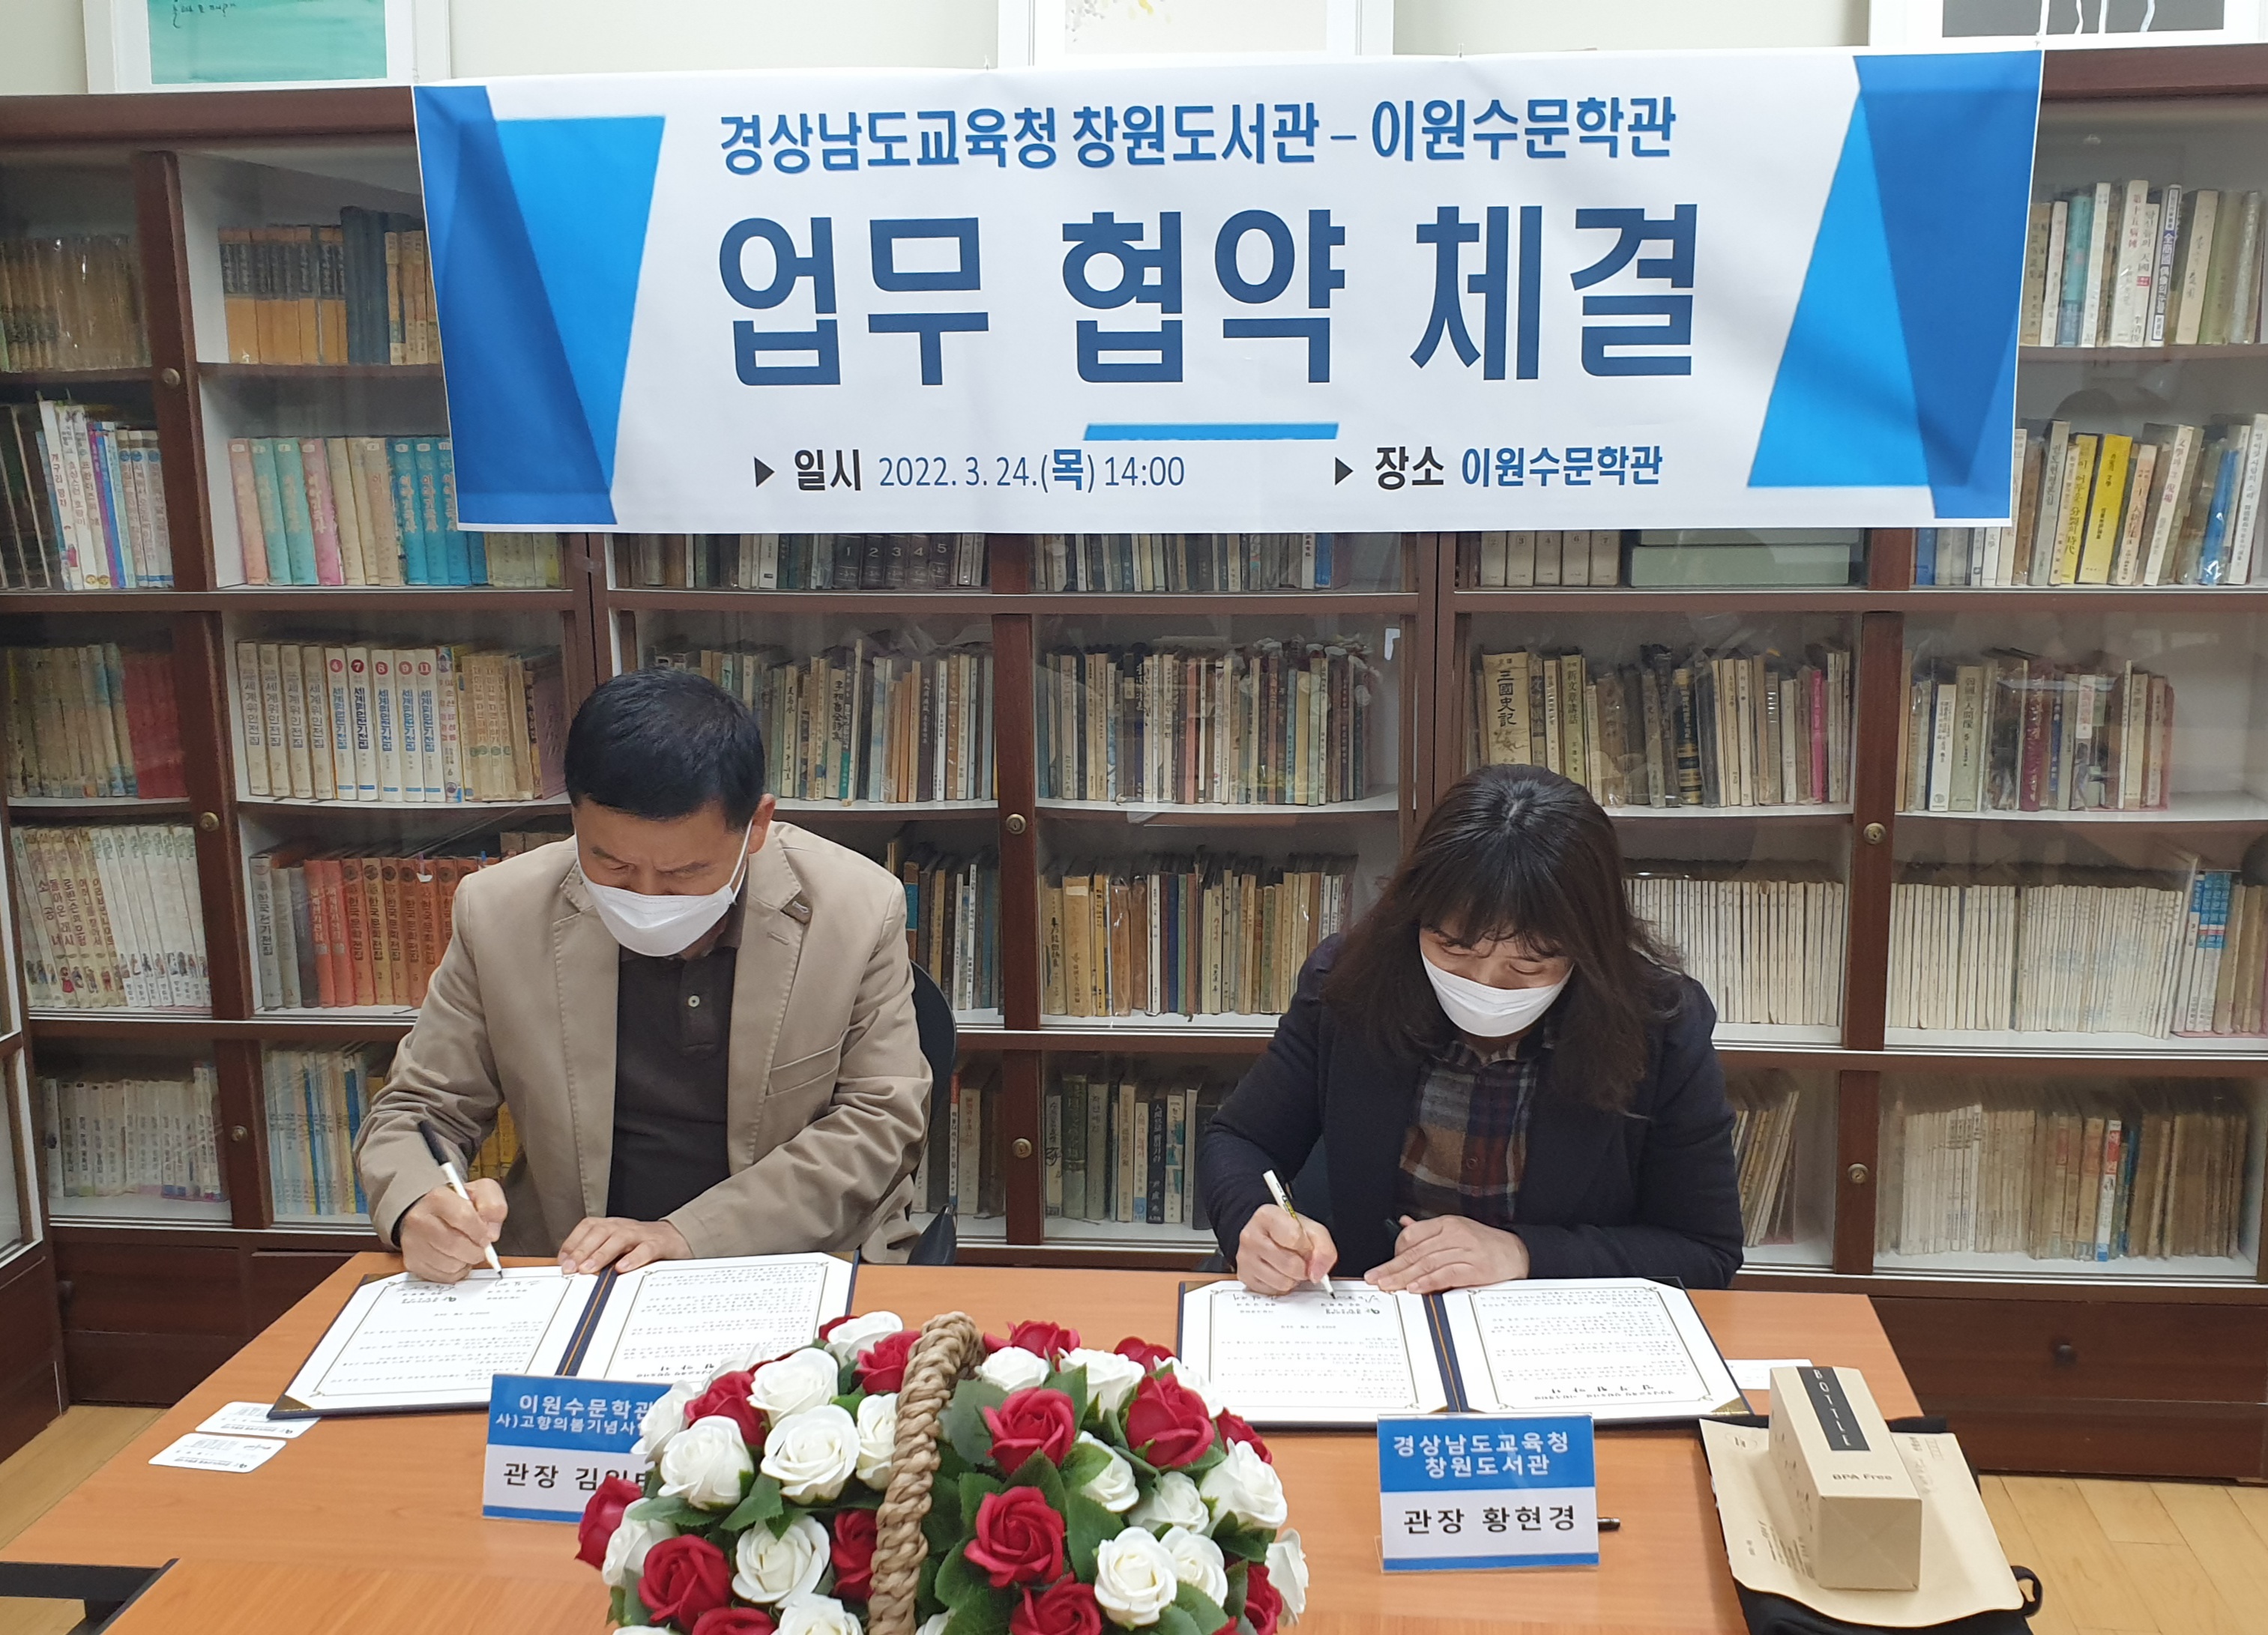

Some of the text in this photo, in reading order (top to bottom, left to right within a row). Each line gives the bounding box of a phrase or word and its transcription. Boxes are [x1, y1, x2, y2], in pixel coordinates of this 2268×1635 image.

[720, 107, 1057, 176] 경상남도교육청
[1073, 102, 1320, 169] 창원도서관
[1372, 96, 1677, 162] 이원수문학관
[719, 203, 1698, 387] 업무 협약 체결
[794, 449, 861, 492] 일시
[878, 456, 957, 486] 2022.
[965, 456, 988, 486] 3.
[1105, 456, 1185, 486] 14:00
[1375, 445, 1663, 491] 장소 이원수문학관
[846, 546, 851, 557] 1
[869, 547, 879, 557] 2
[892, 546, 902, 557] 3
[914, 546, 923, 557] 4
[937, 543, 947, 554] 5
[1497, 670, 1517, 728] 三國史記
[1393, 1430, 1569, 1457] 경상남도교육청
[503, 1462, 559, 1489] 관장
[1425, 1454, 1550, 1479] 창원도서관
[1404, 1505, 1575, 1535] 관장 황현경
